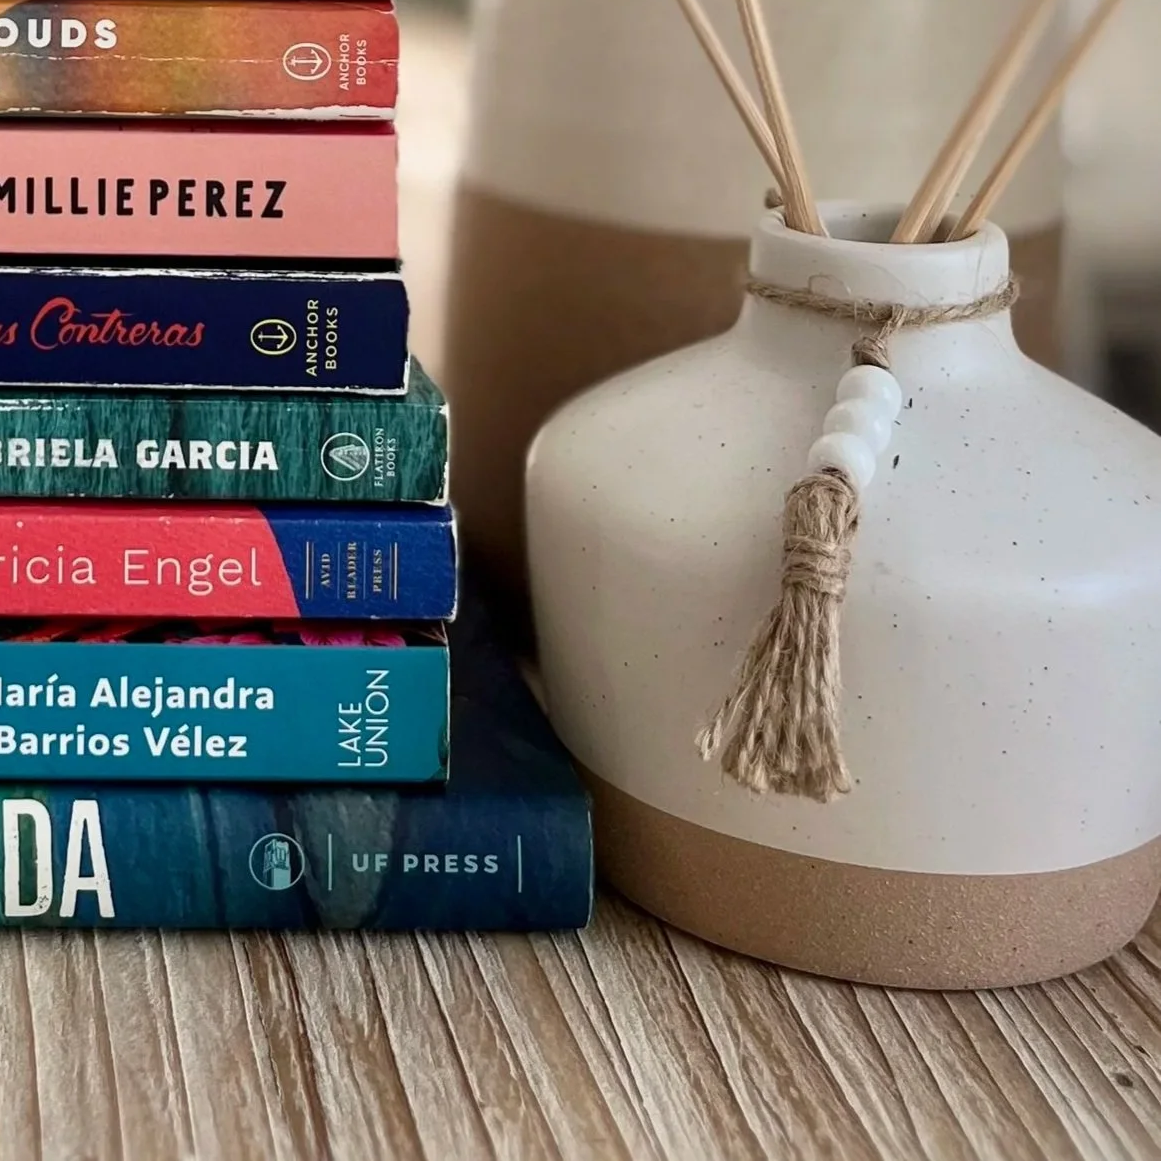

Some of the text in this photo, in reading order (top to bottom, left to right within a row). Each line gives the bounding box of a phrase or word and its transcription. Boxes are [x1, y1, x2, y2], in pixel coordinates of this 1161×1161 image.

[339, 34, 350, 91] ANCHOR
[356, 39, 367, 85] BOOKS
[149, 180, 288, 220] PEREZ
[29, 297, 207, 350] Contreras
[306, 299, 319, 377] ANCHOR
[325, 307, 338, 369] BOOKS
[135, 438, 279, 473] GARCIA
[374, 427, 384, 487] FLATIRON
[386, 438, 396, 477] BOOKS
[123, 543, 263, 596] Engel
[321, 553, 331, 587] AVID
[347, 542, 357, 599] READER
[373, 549, 382, 592] PRESS
[90, 674, 275, 719] Alejandra
[365, 670, 390, 767] UNION
[147, 721, 249, 759] Vélez
[338, 702, 362, 767] LAKE
[352, 853, 499, 874] UF PRESS
